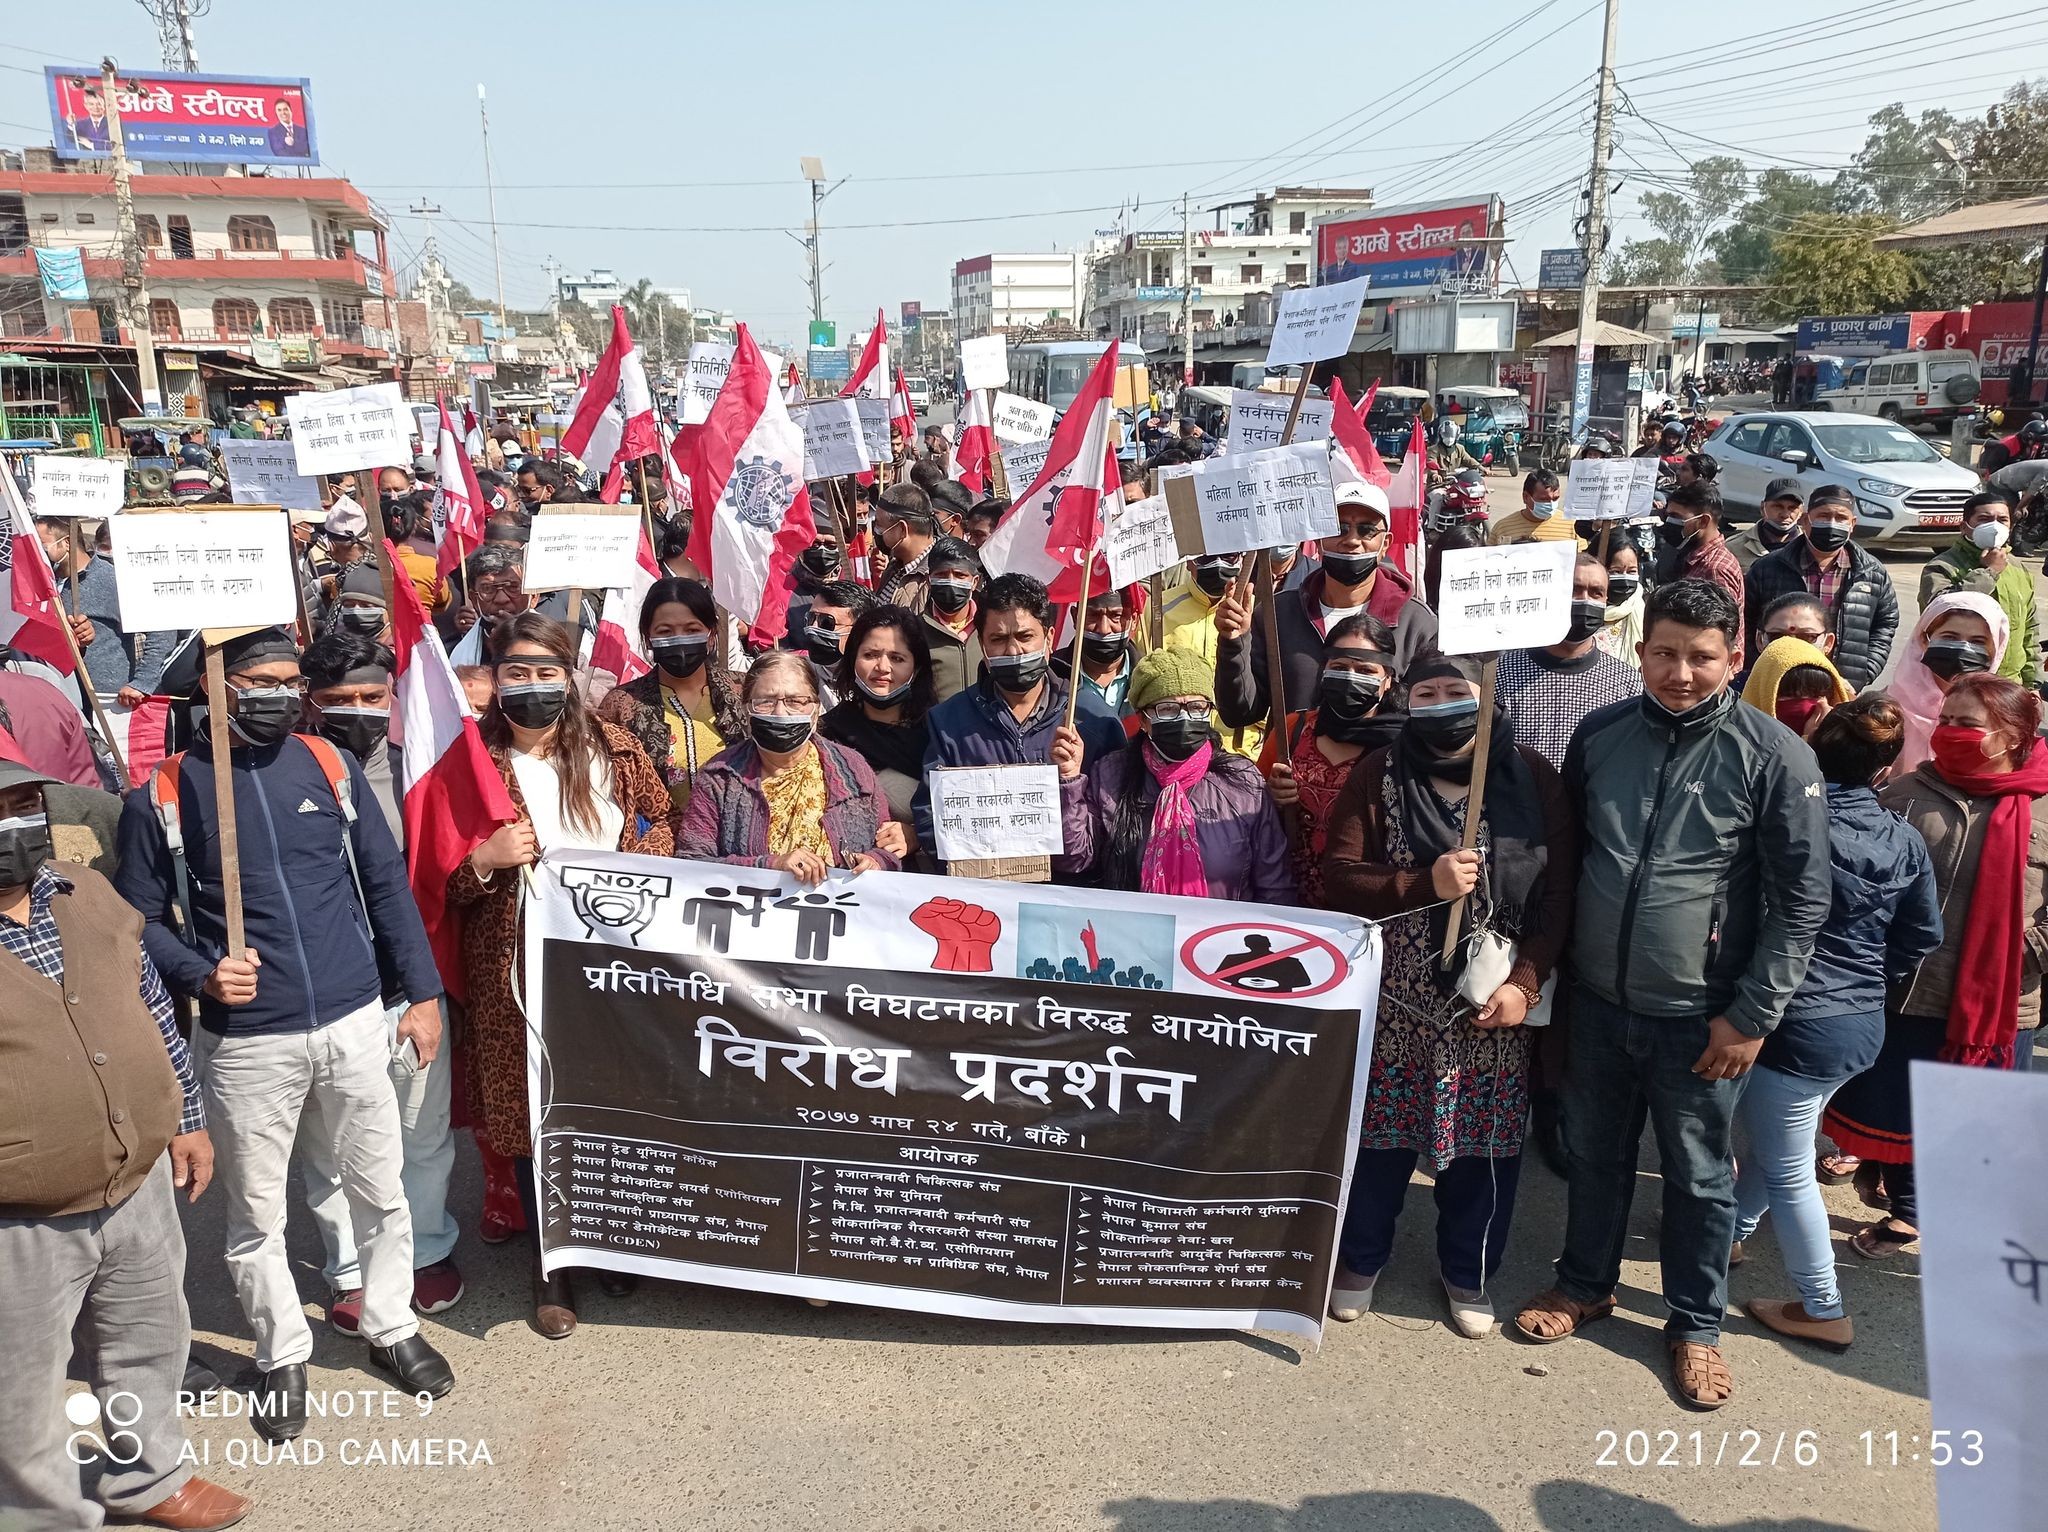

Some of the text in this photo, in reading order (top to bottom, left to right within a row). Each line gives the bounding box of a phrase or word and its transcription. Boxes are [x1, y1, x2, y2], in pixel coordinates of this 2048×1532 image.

[117, 86, 173, 114] अम्बे
[1095, 229, 1120, 237] Cygnett
[1351, 227, 1391, 255] अम्बे
[1471, 273, 1488, 291] डेरी
[1831, 321, 1863, 332] प्रकाश
[1868, 319, 1893, 331] नाग
[299, 413, 345, 431] महिला हिंसा
[360, 429, 384, 442] सरकार
[79, 471, 109, 485] रोजगारी
[1205, 485, 1232, 502] महिला
[1238, 480, 1258, 498] हिंसा
[1264, 479, 1272, 495] र
[1256, 500, 1267, 516] यो
[1273, 497, 1305, 515] सरकार
[205, 542, 232, 565] वर्तमान
[238, 548, 264, 564] सरकार
[153, 575, 195, 596] महामारीमा
[200, 574, 215, 593] पनि
[1484, 569, 1502, 590] चिन्यो
[1506, 566, 1528, 586] वर्तमान
[1532, 568, 1553, 585] सरकार
[1464, 598, 1495, 619] महामारीमा
[1500, 595, 1511, 615] पनि
[944, 790, 1044, 809] वर्तमान सरकारको उपहार
[970, 816, 1004, 834] कुशासन,
[593, 873, 651, 889] NO!
[583, 960, 1318, 1057] प्रतिनिधि सभा विघटनका विरुद्ध आयोजित
[694, 1016, 1198, 1123] विरोध प्रदर्शन
[796, 1107, 1070, 1147] २०७७ माघ २४ गते, बाँके
[572, 1139, 606, 1152] नेपाल
[611, 1142, 631, 1155] ट्रेड
[636, 1146, 678, 1160] यूनियन
[899, 1146, 980, 1166] आयोजक
[571, 1153, 676, 1175] नेपाल शिक्षक संघ
[571, 1168, 605, 1182] नेपाल
[679, 1183, 710, 1195] लयर्स
[715, 1188, 782, 1207] एशोसियसन
[835, 1169, 1001, 1193] प्रजातन्त्रवादी चिकित्सक संघ
[571, 1183, 605, 1197] नेपाल
[672, 1196, 694, 1208] संघ
[834, 1183, 943, 1203] नेपाल प्रेस युनियन
[570, 1200, 769, 1232] प्रजातन्त्रवादी प्राध्यापक संघ, नेपाल
[832, 1199, 1031, 1229] त्रि.वि. प्रजातन्त्रवादी कर्मचारी संघ
[1103, 1195, 1301, 1218] नेपाल निजामती कर्मचारी युनियन
[570, 1213, 602, 1226] सेन्टर
[607, 1218, 628, 1230] फर
[831, 1216, 1058, 1248] लोकतान्त्रिक गैरसरकारी संस्था महासंघ
[1101, 1211, 1207, 1232] नेपाल कुमाल संघ
[569, 1228, 661, 1250] नेपाल (CDEN)
[830, 1232, 865, 1245] नेपाल
[945, 1243, 1016, 1259] एसोशियशन
[1100, 1229, 1172, 1245] लोकतान्त्रिक
[1211, 1236, 1234, 1245] खल
[829, 1249, 1050, 1280] प्रजातान्त्रिक वन प्राविधिक संघ, नेपाल
[1098, 1247, 1314, 1262] प्रजातन्त्रवादि आयुर्वेद चिकित्सक संघ
[1097, 1261, 1267, 1274] नेपाल लोकतान्त्रिक शेर्पा संघ
[2002, 1240, 2048, 1304] पे
[1096, 1277, 1142, 1286] प्रशासन
[1148, 1278, 1212, 1288] व्यवस्थापन
[1231, 1278, 1271, 1288] विकास
[1277, 1277, 1304, 1290] केन्द्र
